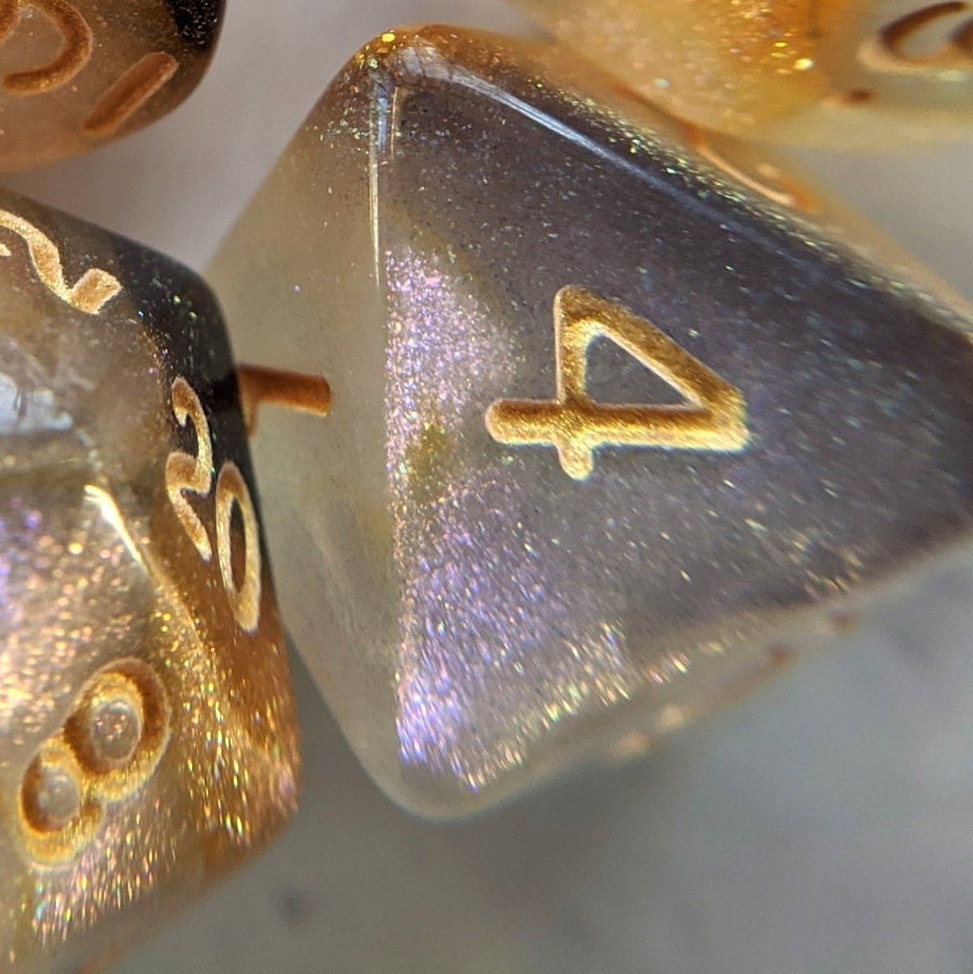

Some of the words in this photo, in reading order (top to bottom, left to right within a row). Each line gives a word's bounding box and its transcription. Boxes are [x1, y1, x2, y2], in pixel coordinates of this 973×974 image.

[485, 284, 751, 482] 4
[165, 375, 263, 631] 20
[21, 657, 173, 869] 8
